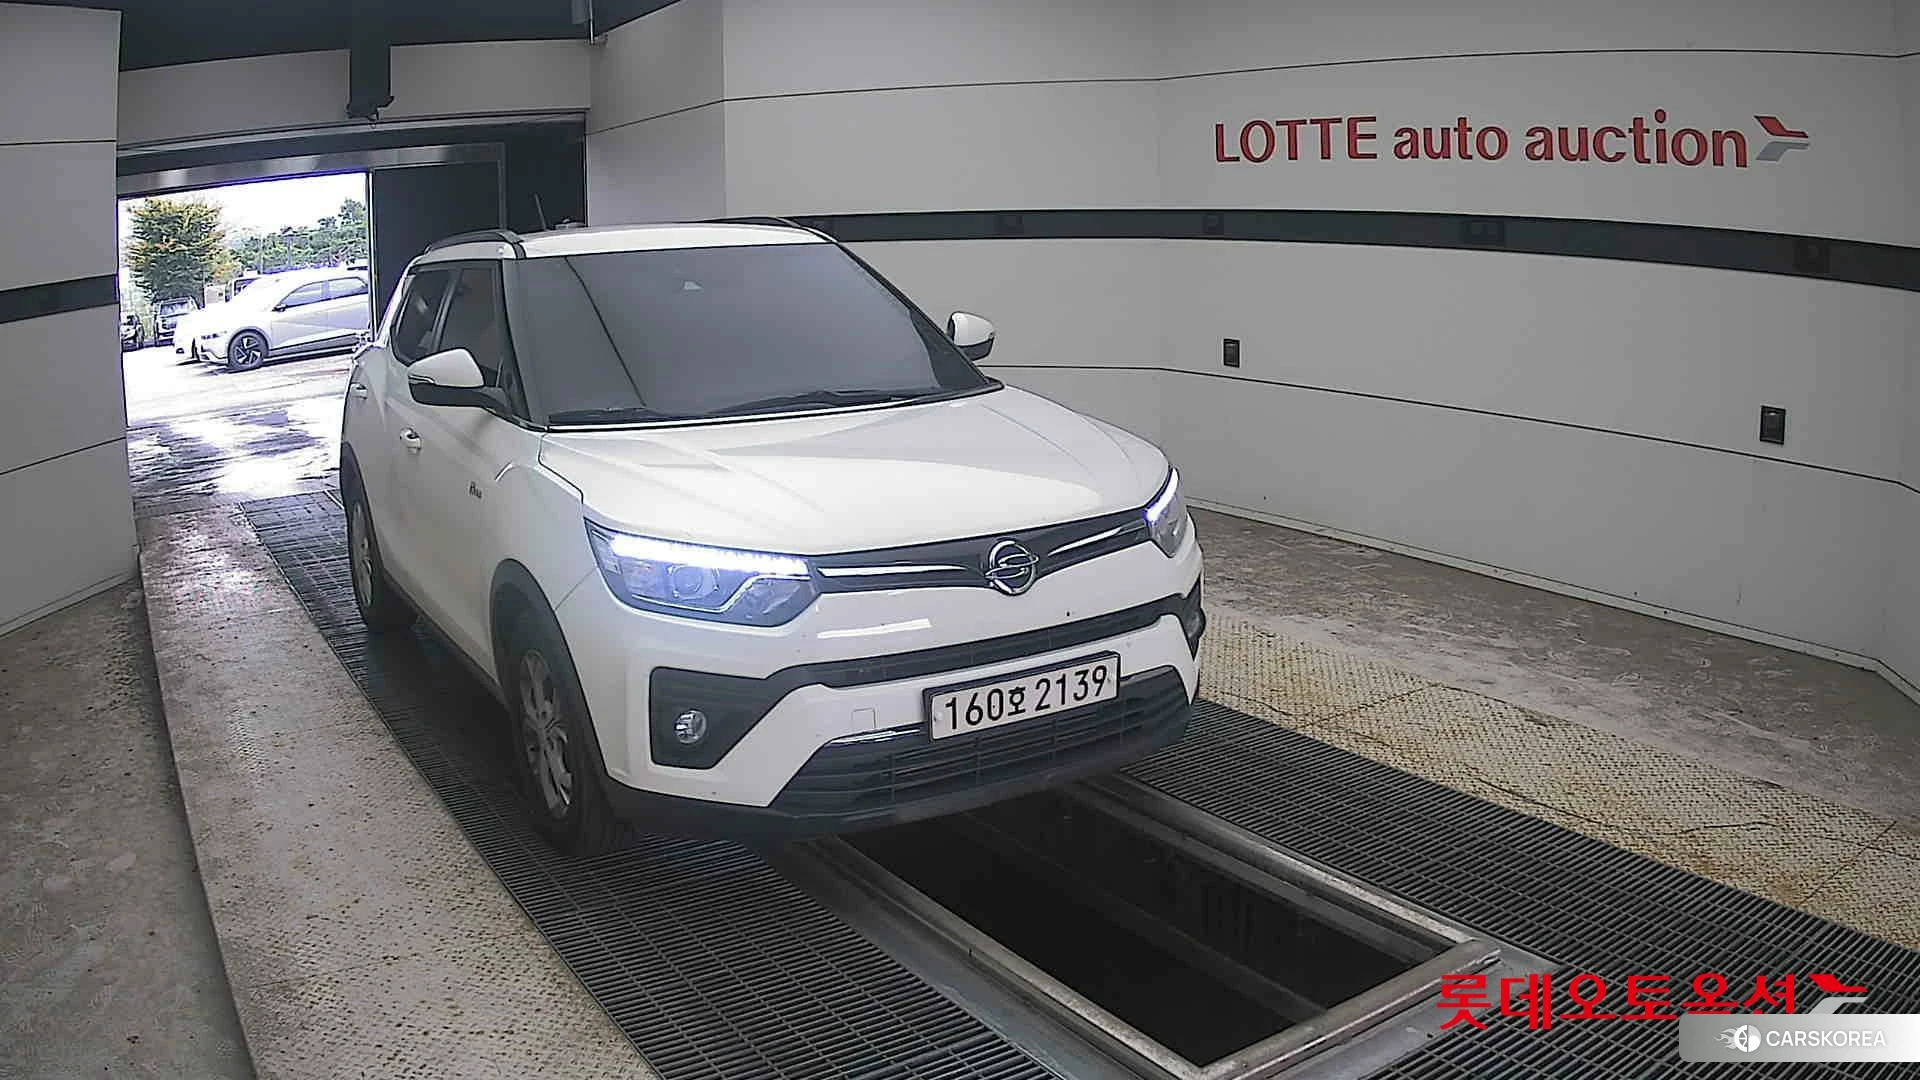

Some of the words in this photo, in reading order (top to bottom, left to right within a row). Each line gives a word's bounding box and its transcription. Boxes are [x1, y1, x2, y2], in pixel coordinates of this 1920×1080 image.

[1215, 116, 1378, 163] LOTTE
[1393, 117, 1509, 161] auto
[1524, 109, 1748, 169] auction
